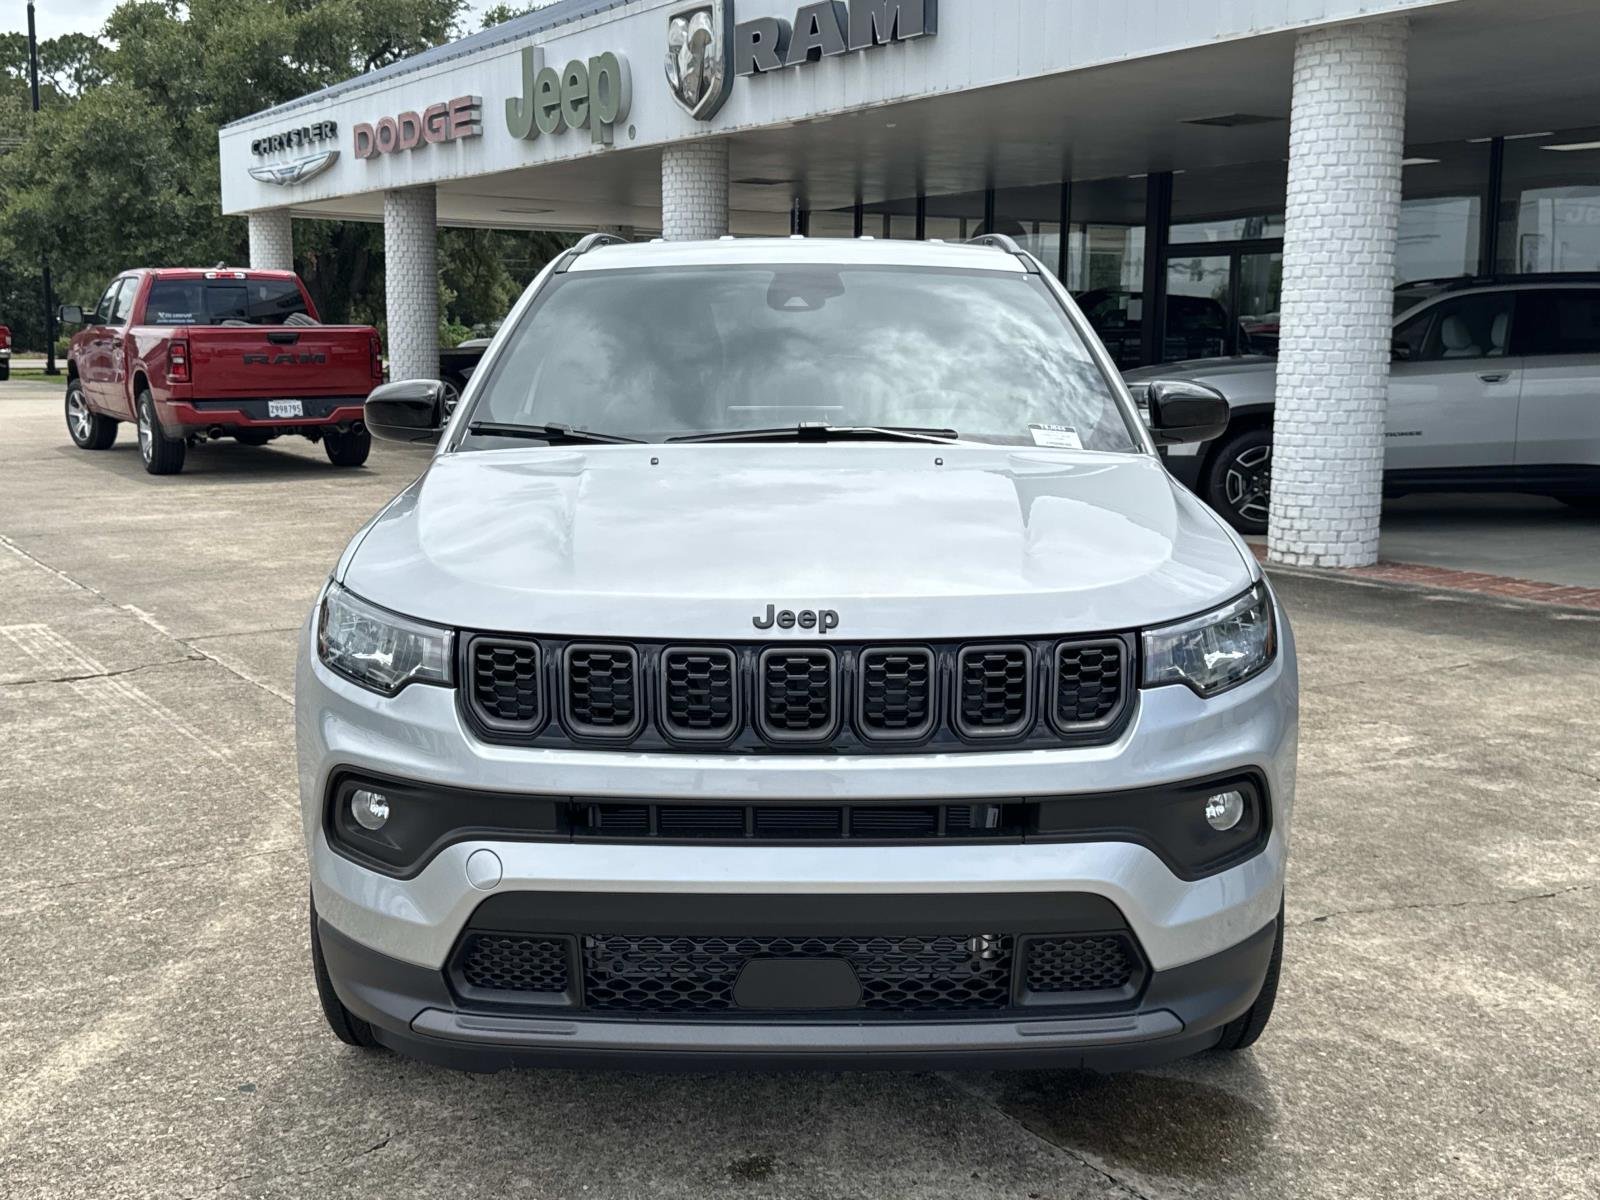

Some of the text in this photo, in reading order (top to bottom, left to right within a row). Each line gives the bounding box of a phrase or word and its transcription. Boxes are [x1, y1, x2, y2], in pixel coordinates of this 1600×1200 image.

[734, 0, 934, 76] RAM
[506, 46, 630, 144] Jeep
[251, 120, 338, 156] CHRYSLER
[354, 95, 482, 159] DODGE
[243, 353, 326, 365] RAM
[752, 604, 839, 634] Jeep
